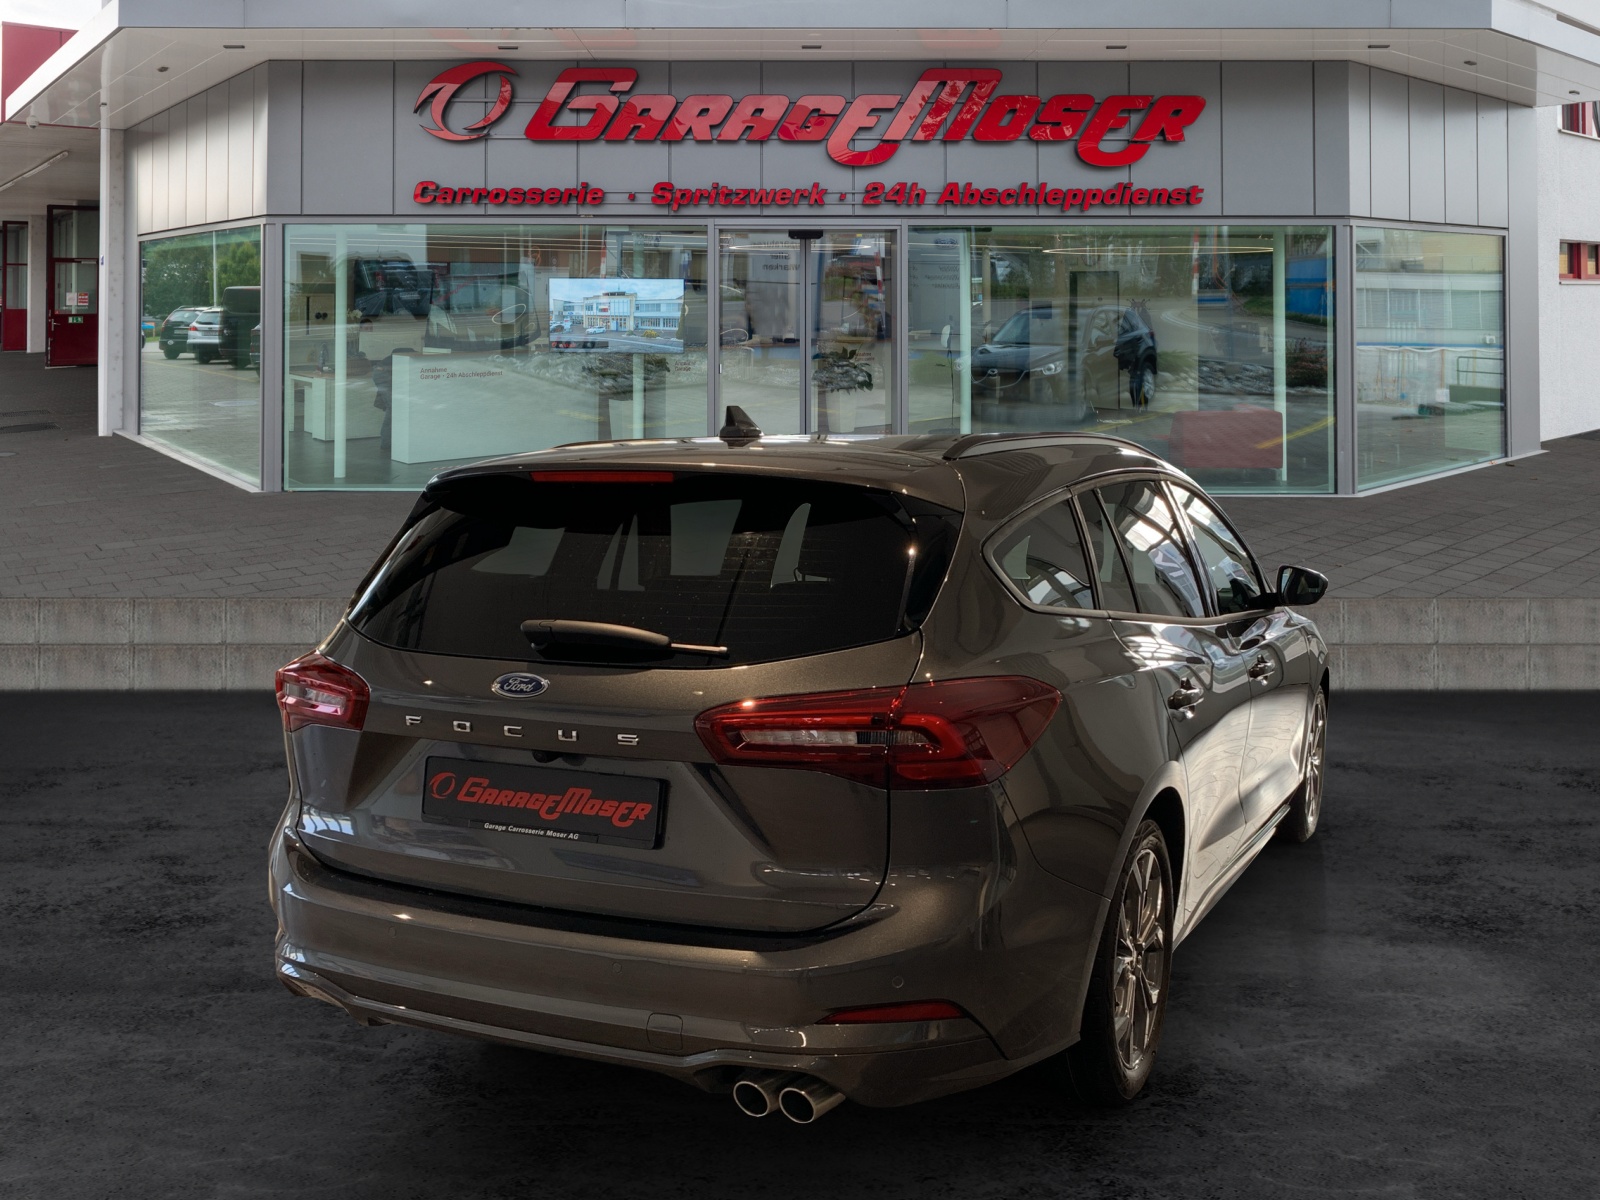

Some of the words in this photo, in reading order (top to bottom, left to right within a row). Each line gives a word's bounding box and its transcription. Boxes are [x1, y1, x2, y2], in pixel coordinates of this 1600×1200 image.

[413, 181, 604, 205] Carrosserie
[651, 182, 826, 211] Spritzwerk
[862, 182, 926, 205] 24h
[937, 182, 1204, 212] Abschleppdienst
[458, 370, 503, 378] Abschleppdienst
[503, 677, 535, 693] Ford
[405, 715, 639, 746] FOCUS
[484, 822, 507, 832] Garage
[507, 825, 545, 836] Carrosserie
[546, 829, 567, 840] Moser
